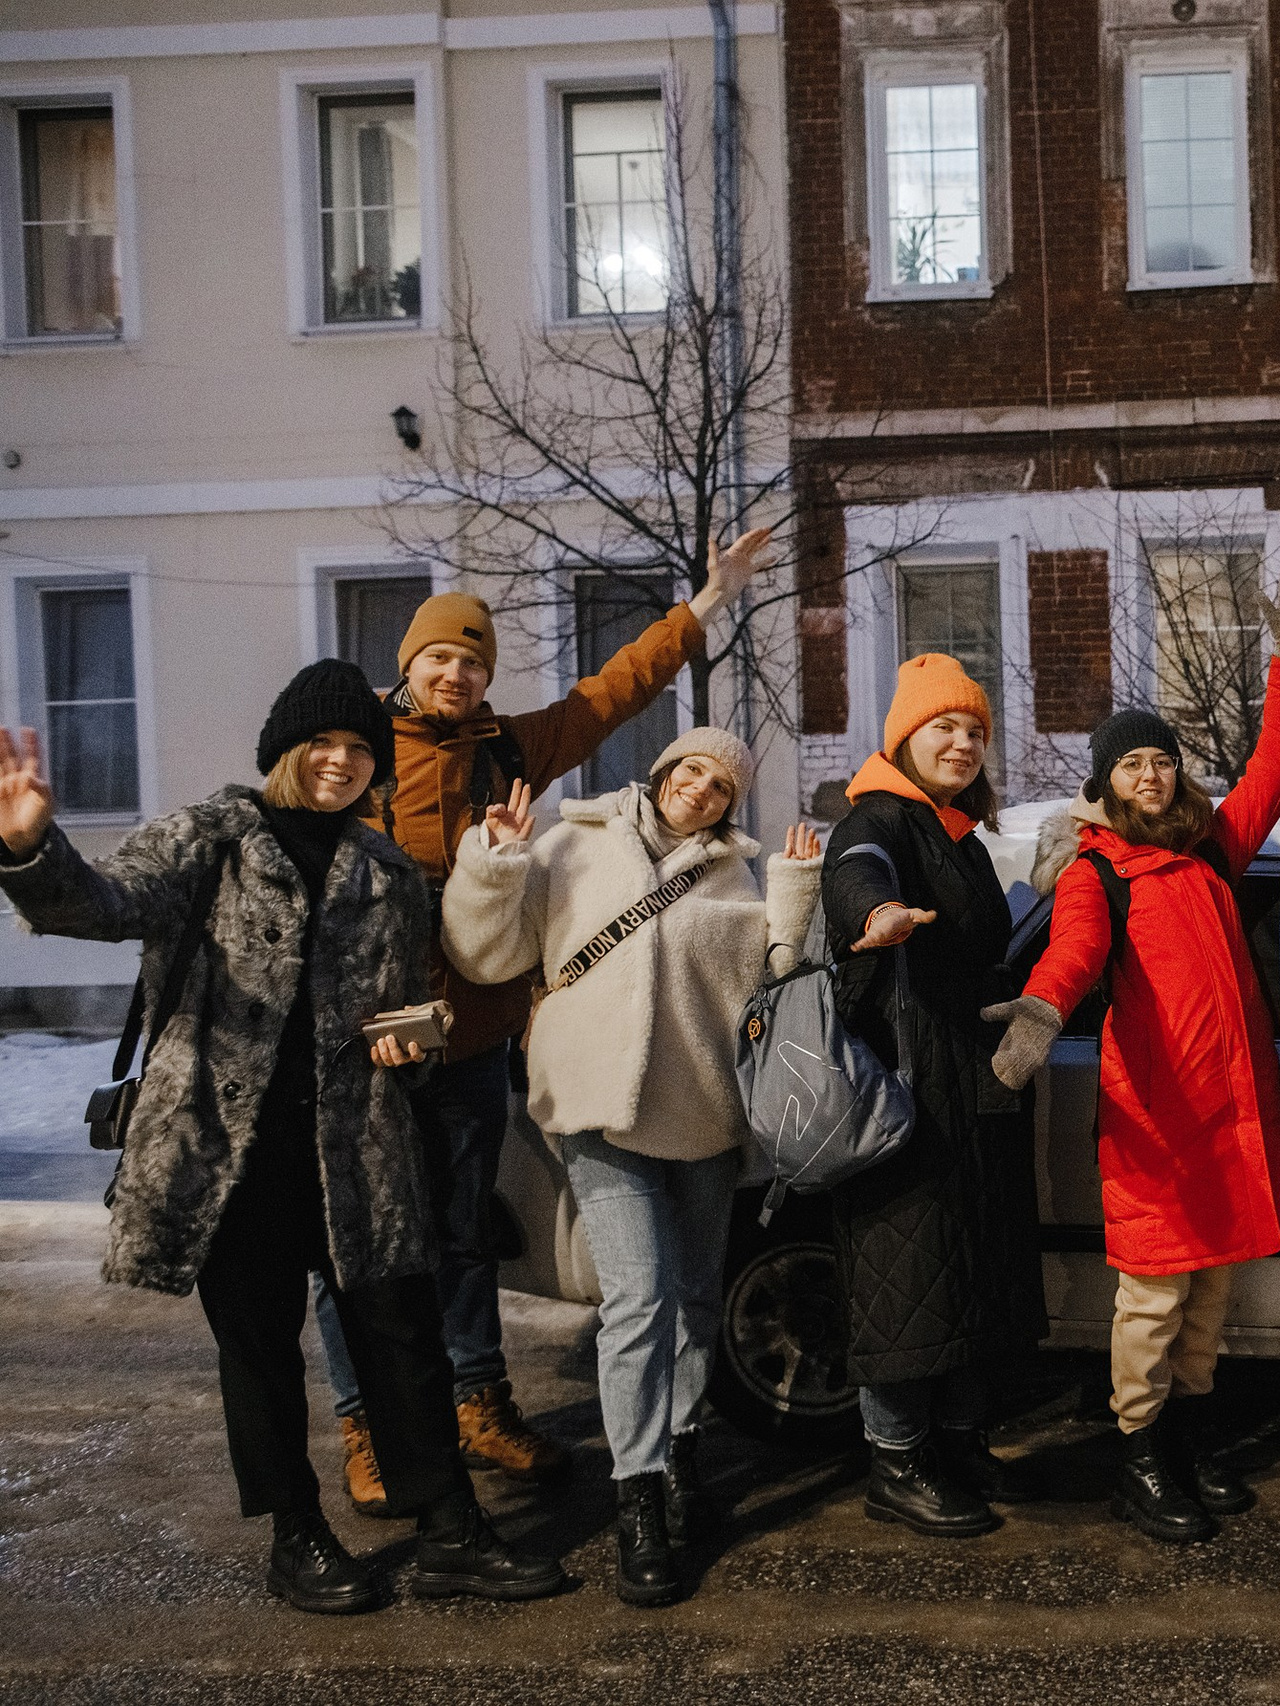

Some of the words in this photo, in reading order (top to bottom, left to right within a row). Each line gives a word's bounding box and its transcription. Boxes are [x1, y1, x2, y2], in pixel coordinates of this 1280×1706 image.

[616, 874, 691, 937] ORDINARY
[582, 929, 618, 966] NOT
[561, 958, 585, 986] OR
